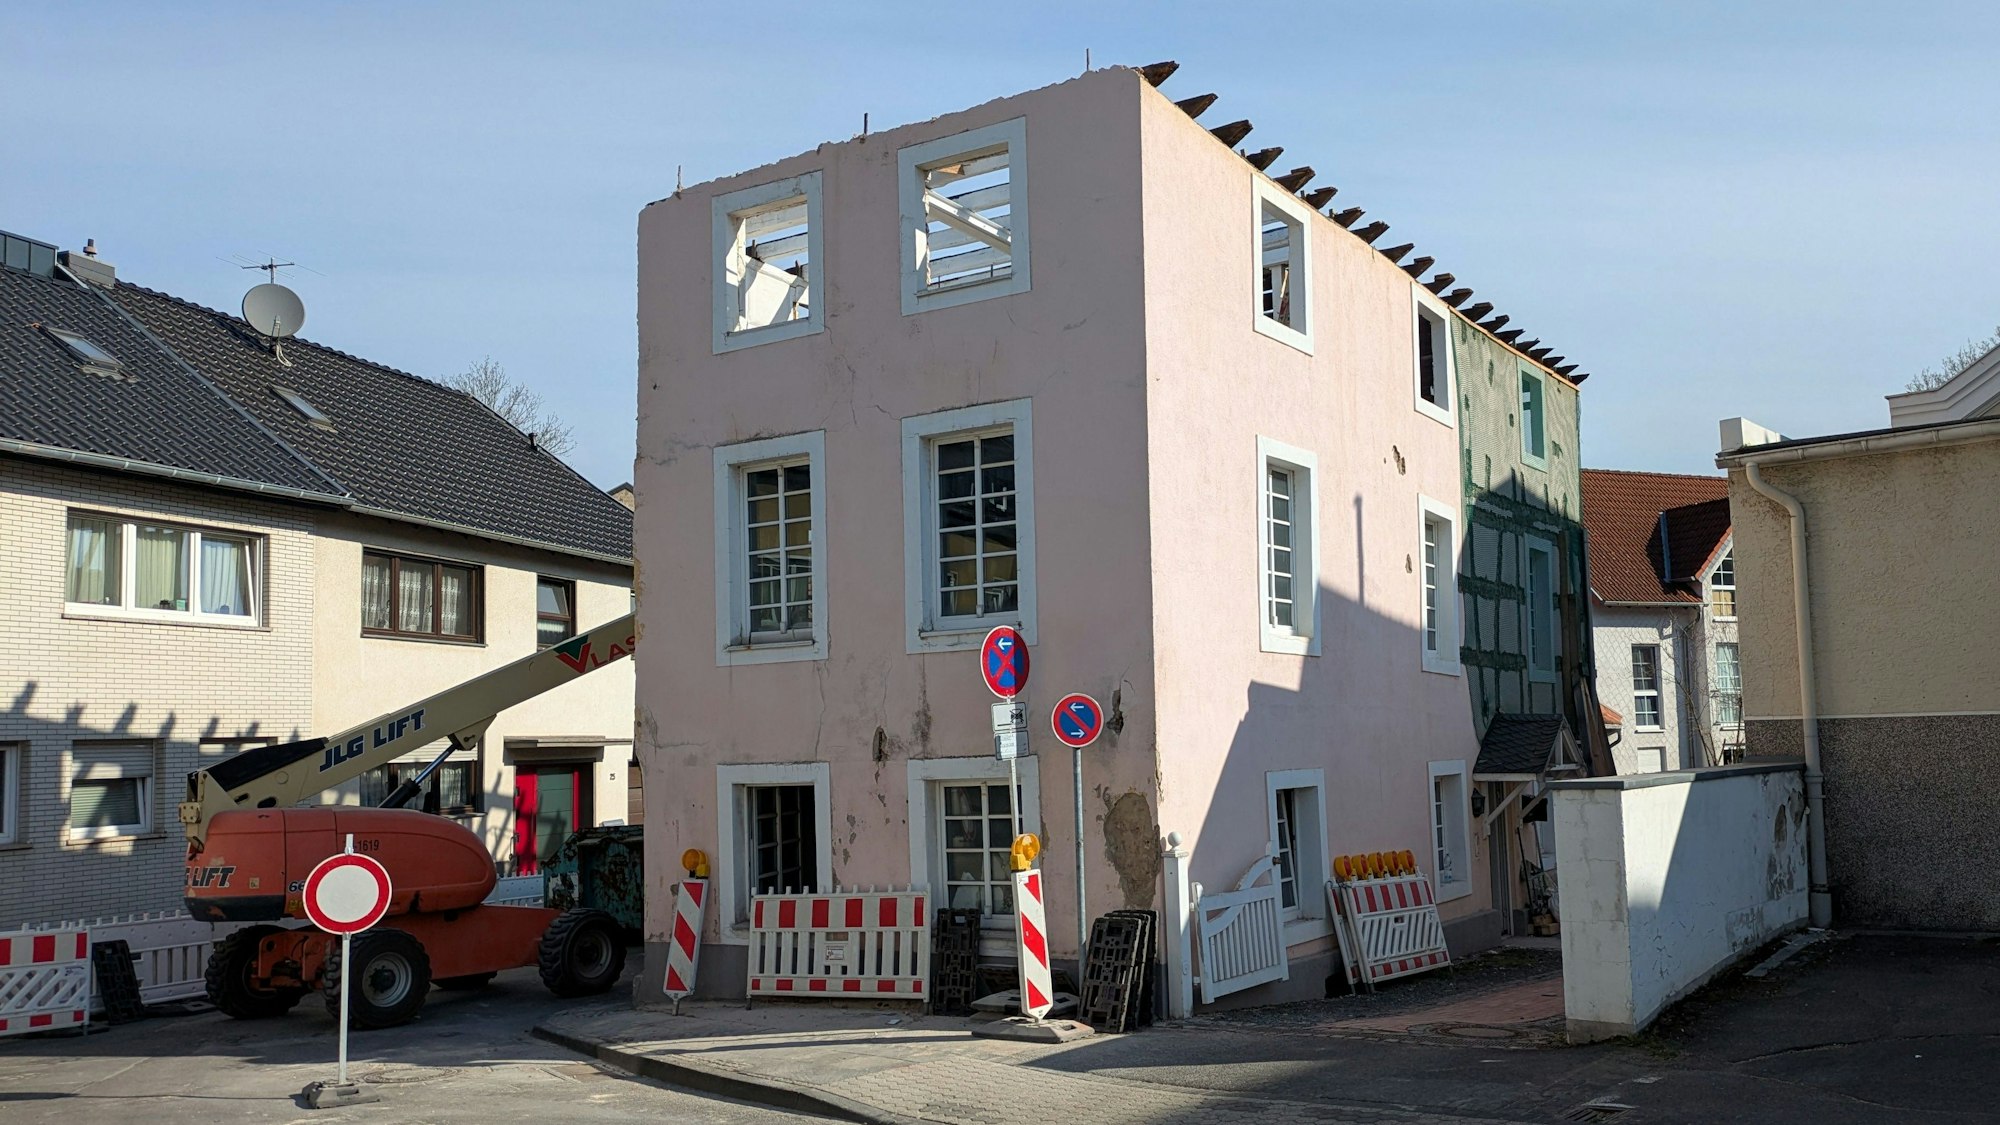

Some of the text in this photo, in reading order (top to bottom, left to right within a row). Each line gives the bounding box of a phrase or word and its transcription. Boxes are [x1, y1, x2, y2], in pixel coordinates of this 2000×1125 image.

[319, 708, 424, 773] JLG LIFT
[192, 866, 236, 888] LIFT
